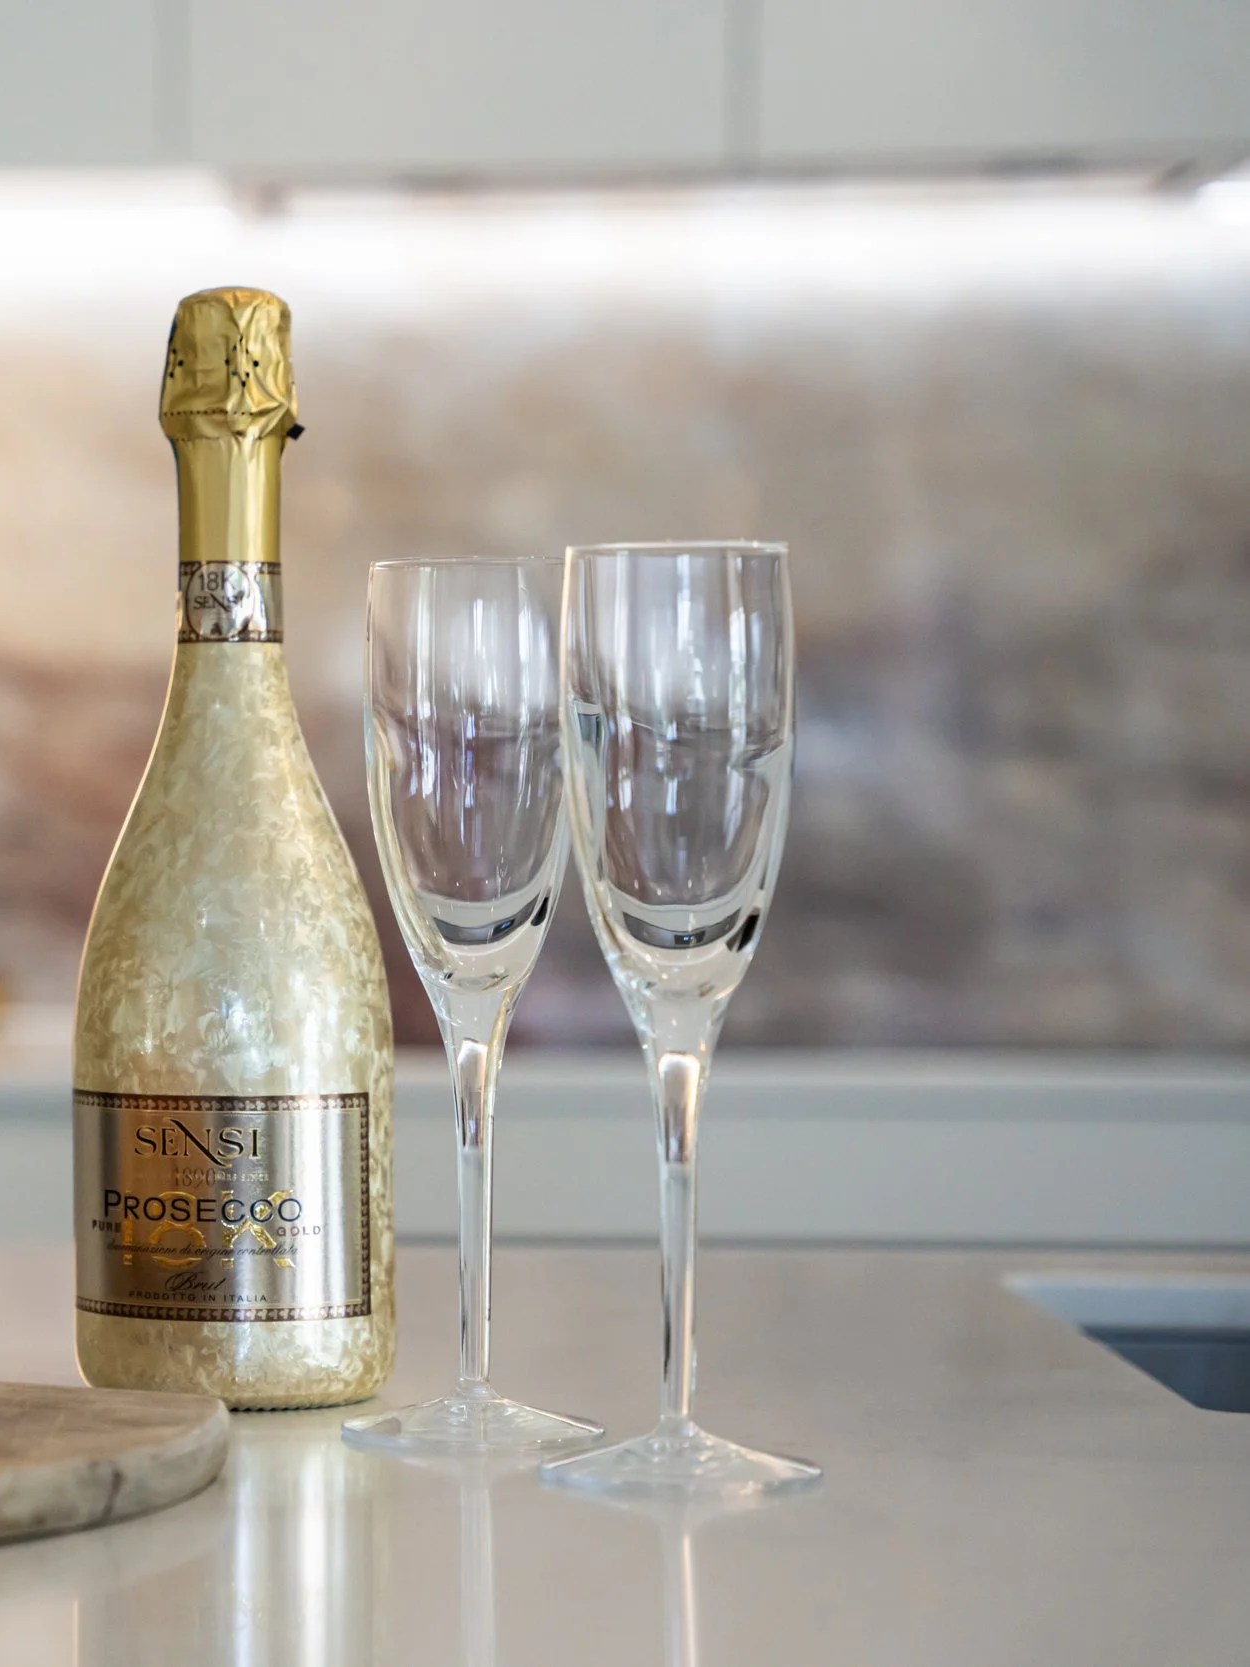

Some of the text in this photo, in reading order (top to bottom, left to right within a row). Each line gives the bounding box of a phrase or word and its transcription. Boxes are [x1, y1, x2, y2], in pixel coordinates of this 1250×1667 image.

[134, 1118, 262, 1167] SENSI
[174, 1167, 216, 1188] 1890
[103, 1188, 303, 1223] PROSECCO
[91, 1219, 121, 1233] PURE
[277, 1225, 322, 1237] GOLD
[164, 1271, 227, 1292] Brut
[128, 1290, 267, 1303] PRODOTTO IN ITALIA
